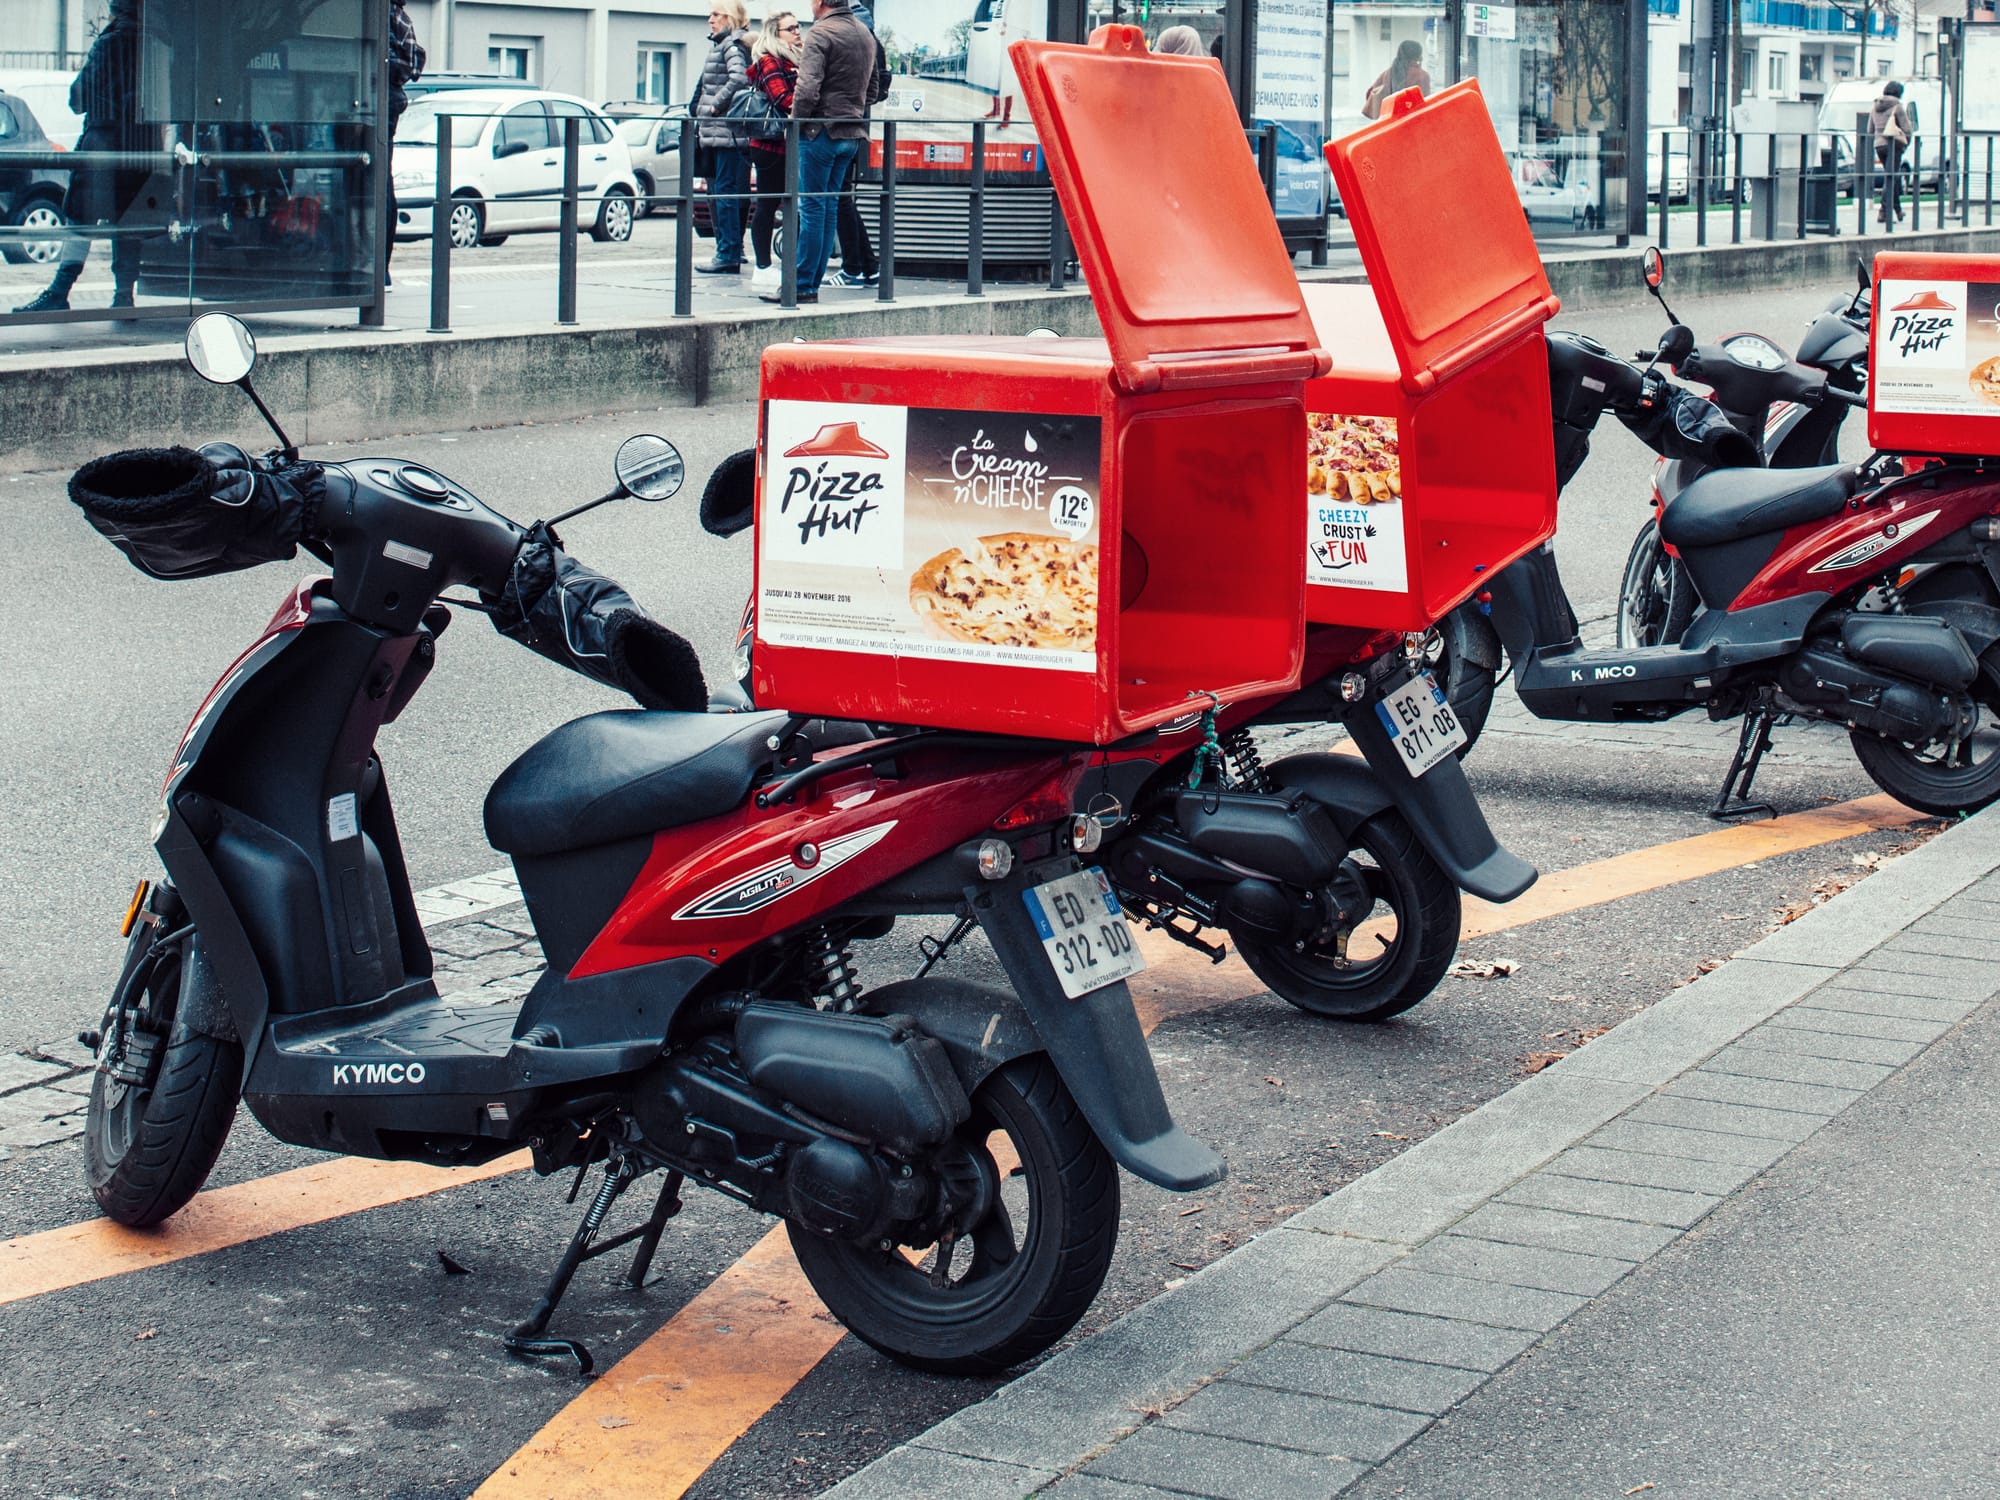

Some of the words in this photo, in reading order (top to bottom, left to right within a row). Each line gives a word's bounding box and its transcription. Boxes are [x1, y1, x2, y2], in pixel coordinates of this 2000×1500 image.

[1889, 312, 1954, 341] Pizza
[1900, 334, 1951, 358] Hut
[951, 446, 1048, 480] Cream
[780, 460, 885, 514] Pizza
[1059, 494, 1088, 520] 12€
[1319, 508, 1369, 524] CHEEZY
[797, 499, 880, 545] Hut
[1060, 519, 1087, 528] EMPORTER
[1323, 523, 1362, 541] CRUST
[1326, 540, 1368, 565] FUN
[764, 588, 793, 599] JUSQU'AU
[803, 592, 835, 602] NOVEMBRE
[838, 595, 851, 603] 2016
[780, 632, 795, 641] POUR
[797, 633, 813, 642] VOTRE
[836, 637, 860, 646] MANGEZ
[860, 639, 868, 647] AU
[870, 640, 889, 649] MOINS
[904, 643, 924, 653] FRUITS
[926, 645, 933, 653] ET
[963, 648, 974, 657] PAR
[975, 649, 990, 657] JOUR
[996, 651, 1073, 664] WWW.MANGERBOUGER.FR
[739, 872, 783, 901] AGILITY
[333, 1062, 426, 1085] KYMCO
